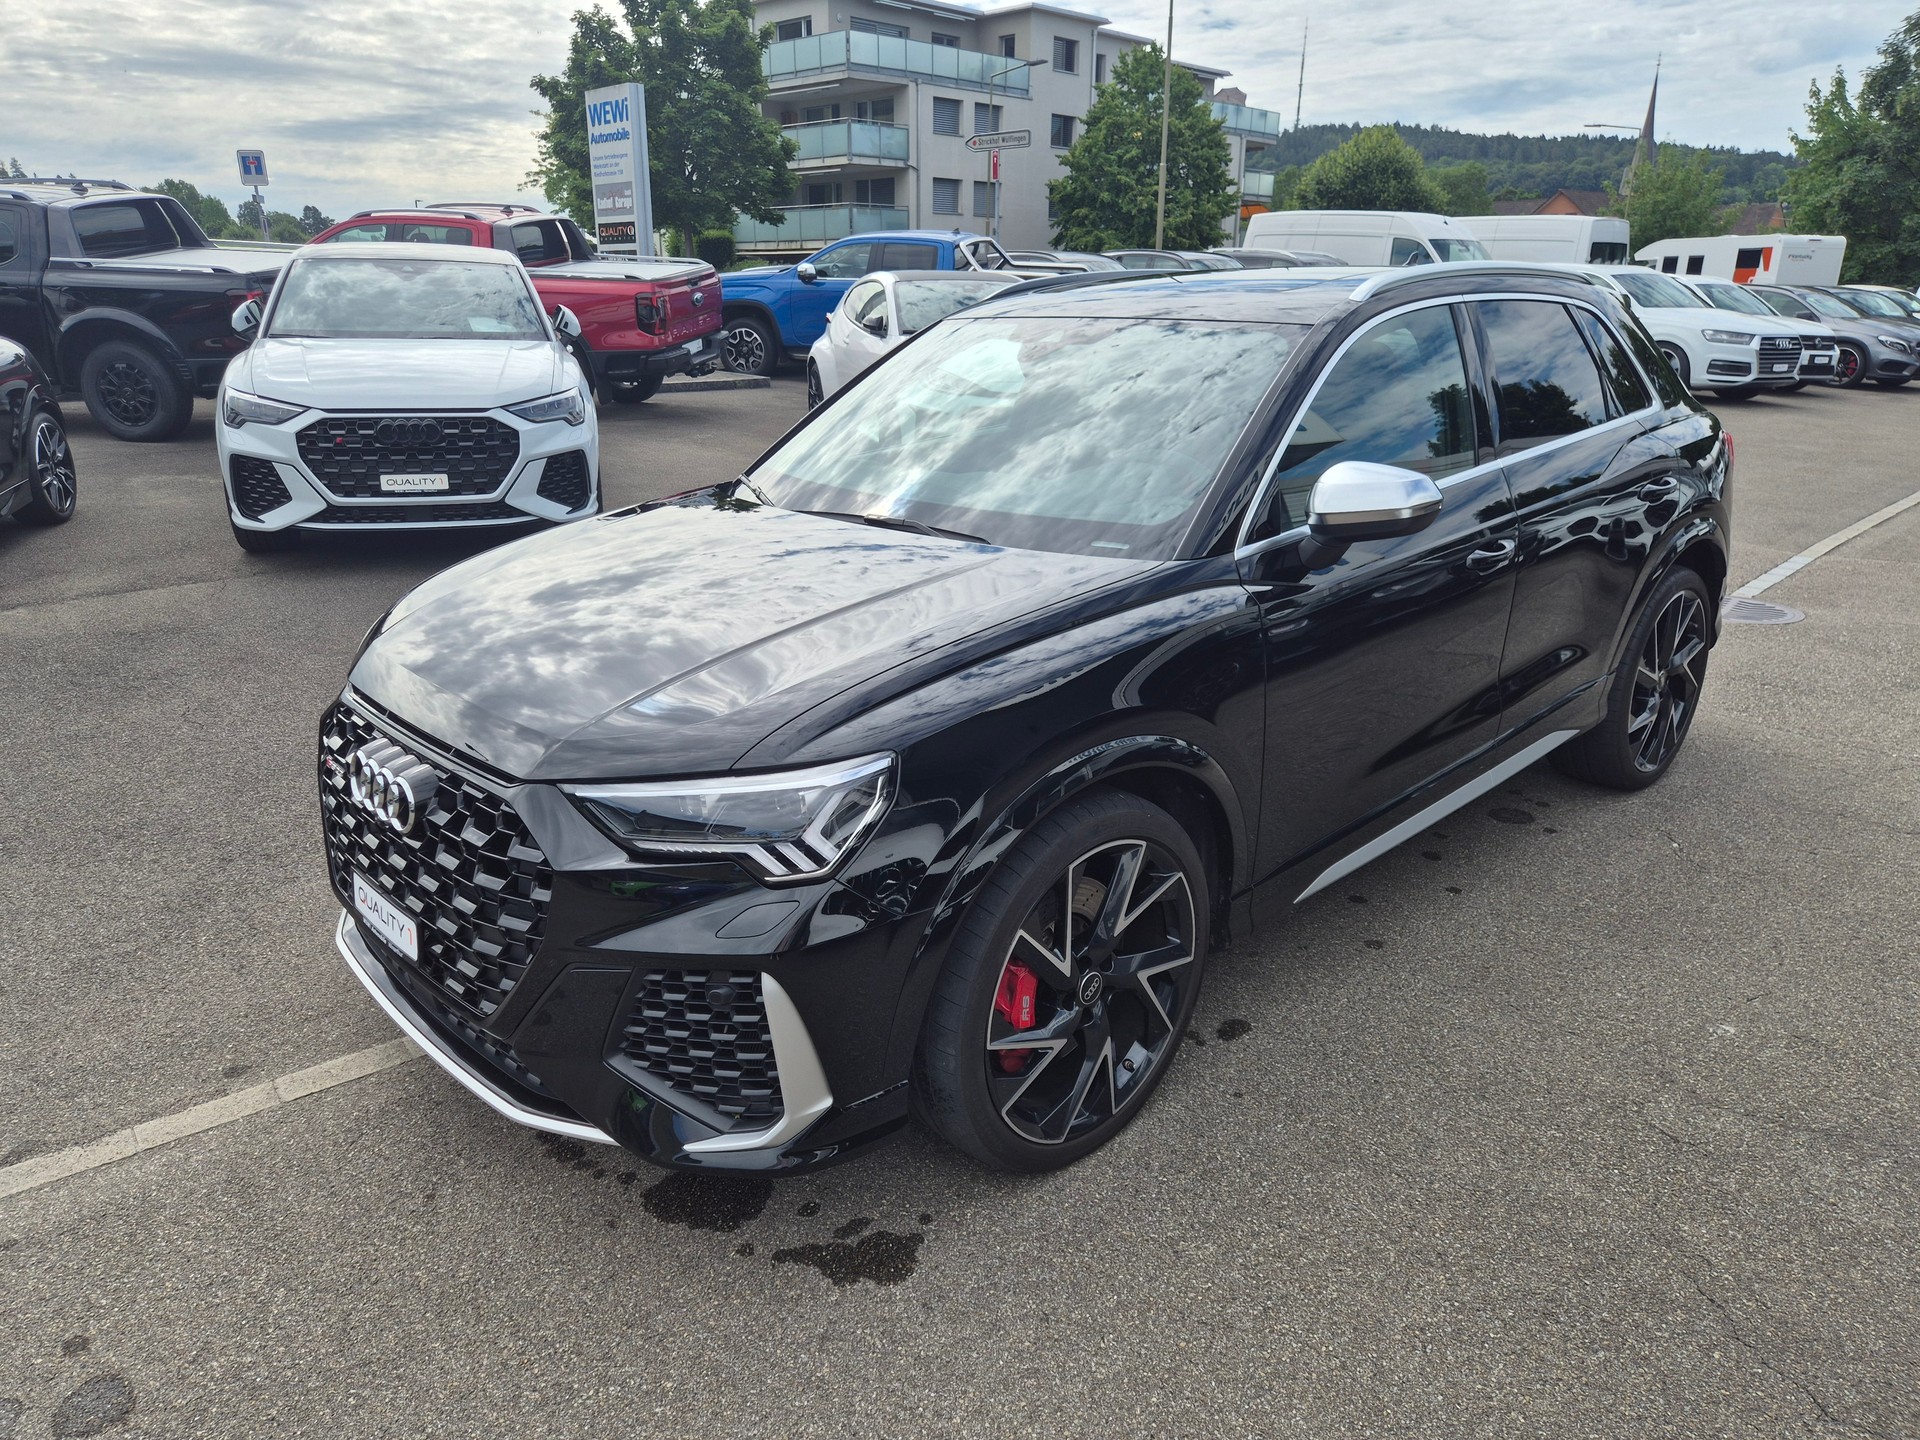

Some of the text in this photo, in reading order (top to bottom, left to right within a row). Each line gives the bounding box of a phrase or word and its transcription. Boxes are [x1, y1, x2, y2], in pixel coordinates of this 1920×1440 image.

[588, 96, 629, 127] WEWi
[591, 127, 630, 145] Automobile
[978, 137, 1000, 146] Strickhof
[600, 226, 627, 237] QUALITY
[386, 478, 437, 486] QUALITY
[358, 886, 406, 938] QUALITY
[407, 927, 414, 946] 1
[1022, 995, 1030, 1021] RS
